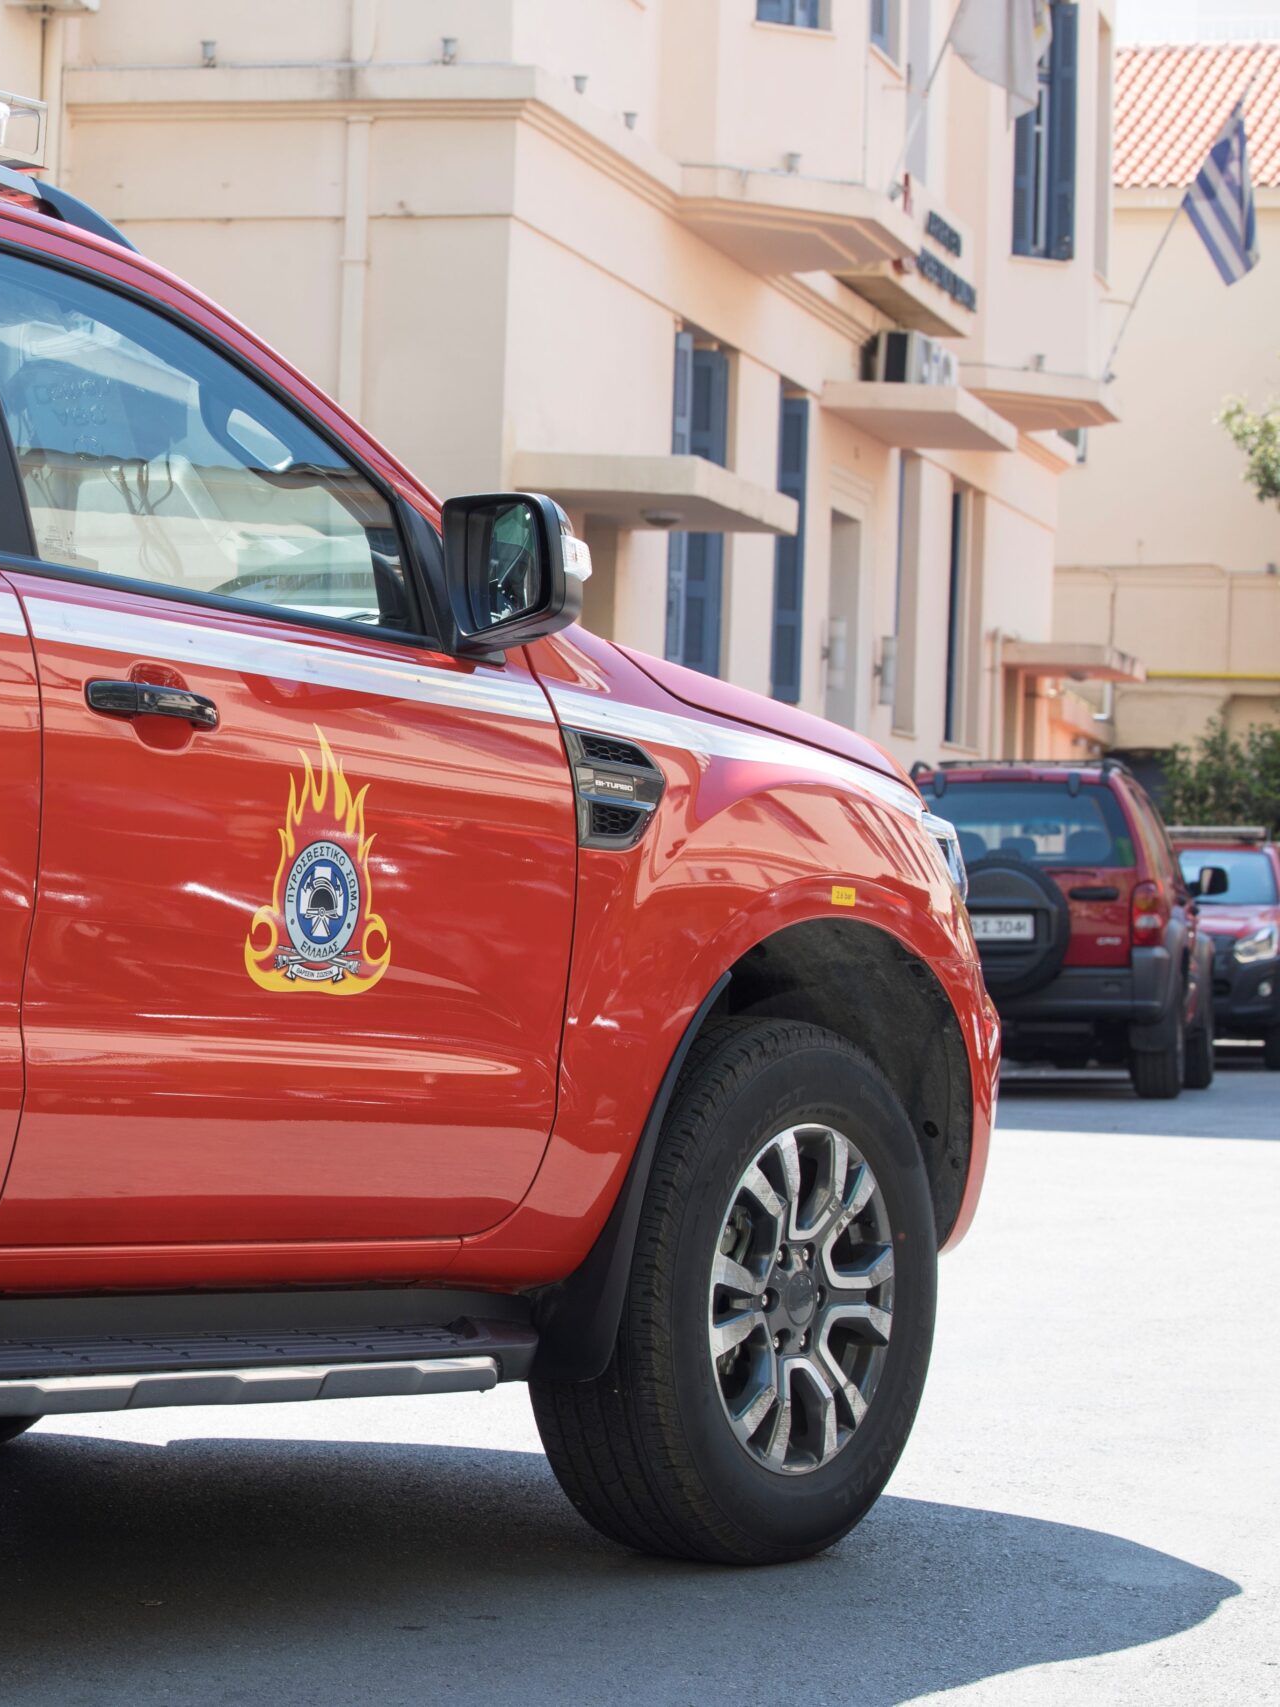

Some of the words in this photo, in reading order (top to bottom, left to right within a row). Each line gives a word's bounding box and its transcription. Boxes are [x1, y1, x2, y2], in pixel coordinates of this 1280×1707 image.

[595, 779, 633, 791] BI-TURBO
[287, 846, 346, 903] ΠΥΡΟΣΒΕΣΤΙΚΟ
[345, 868, 358, 912] ΣΩΜΑ
[300, 940, 340, 959] ΕΛΛΑΔΑΣ
